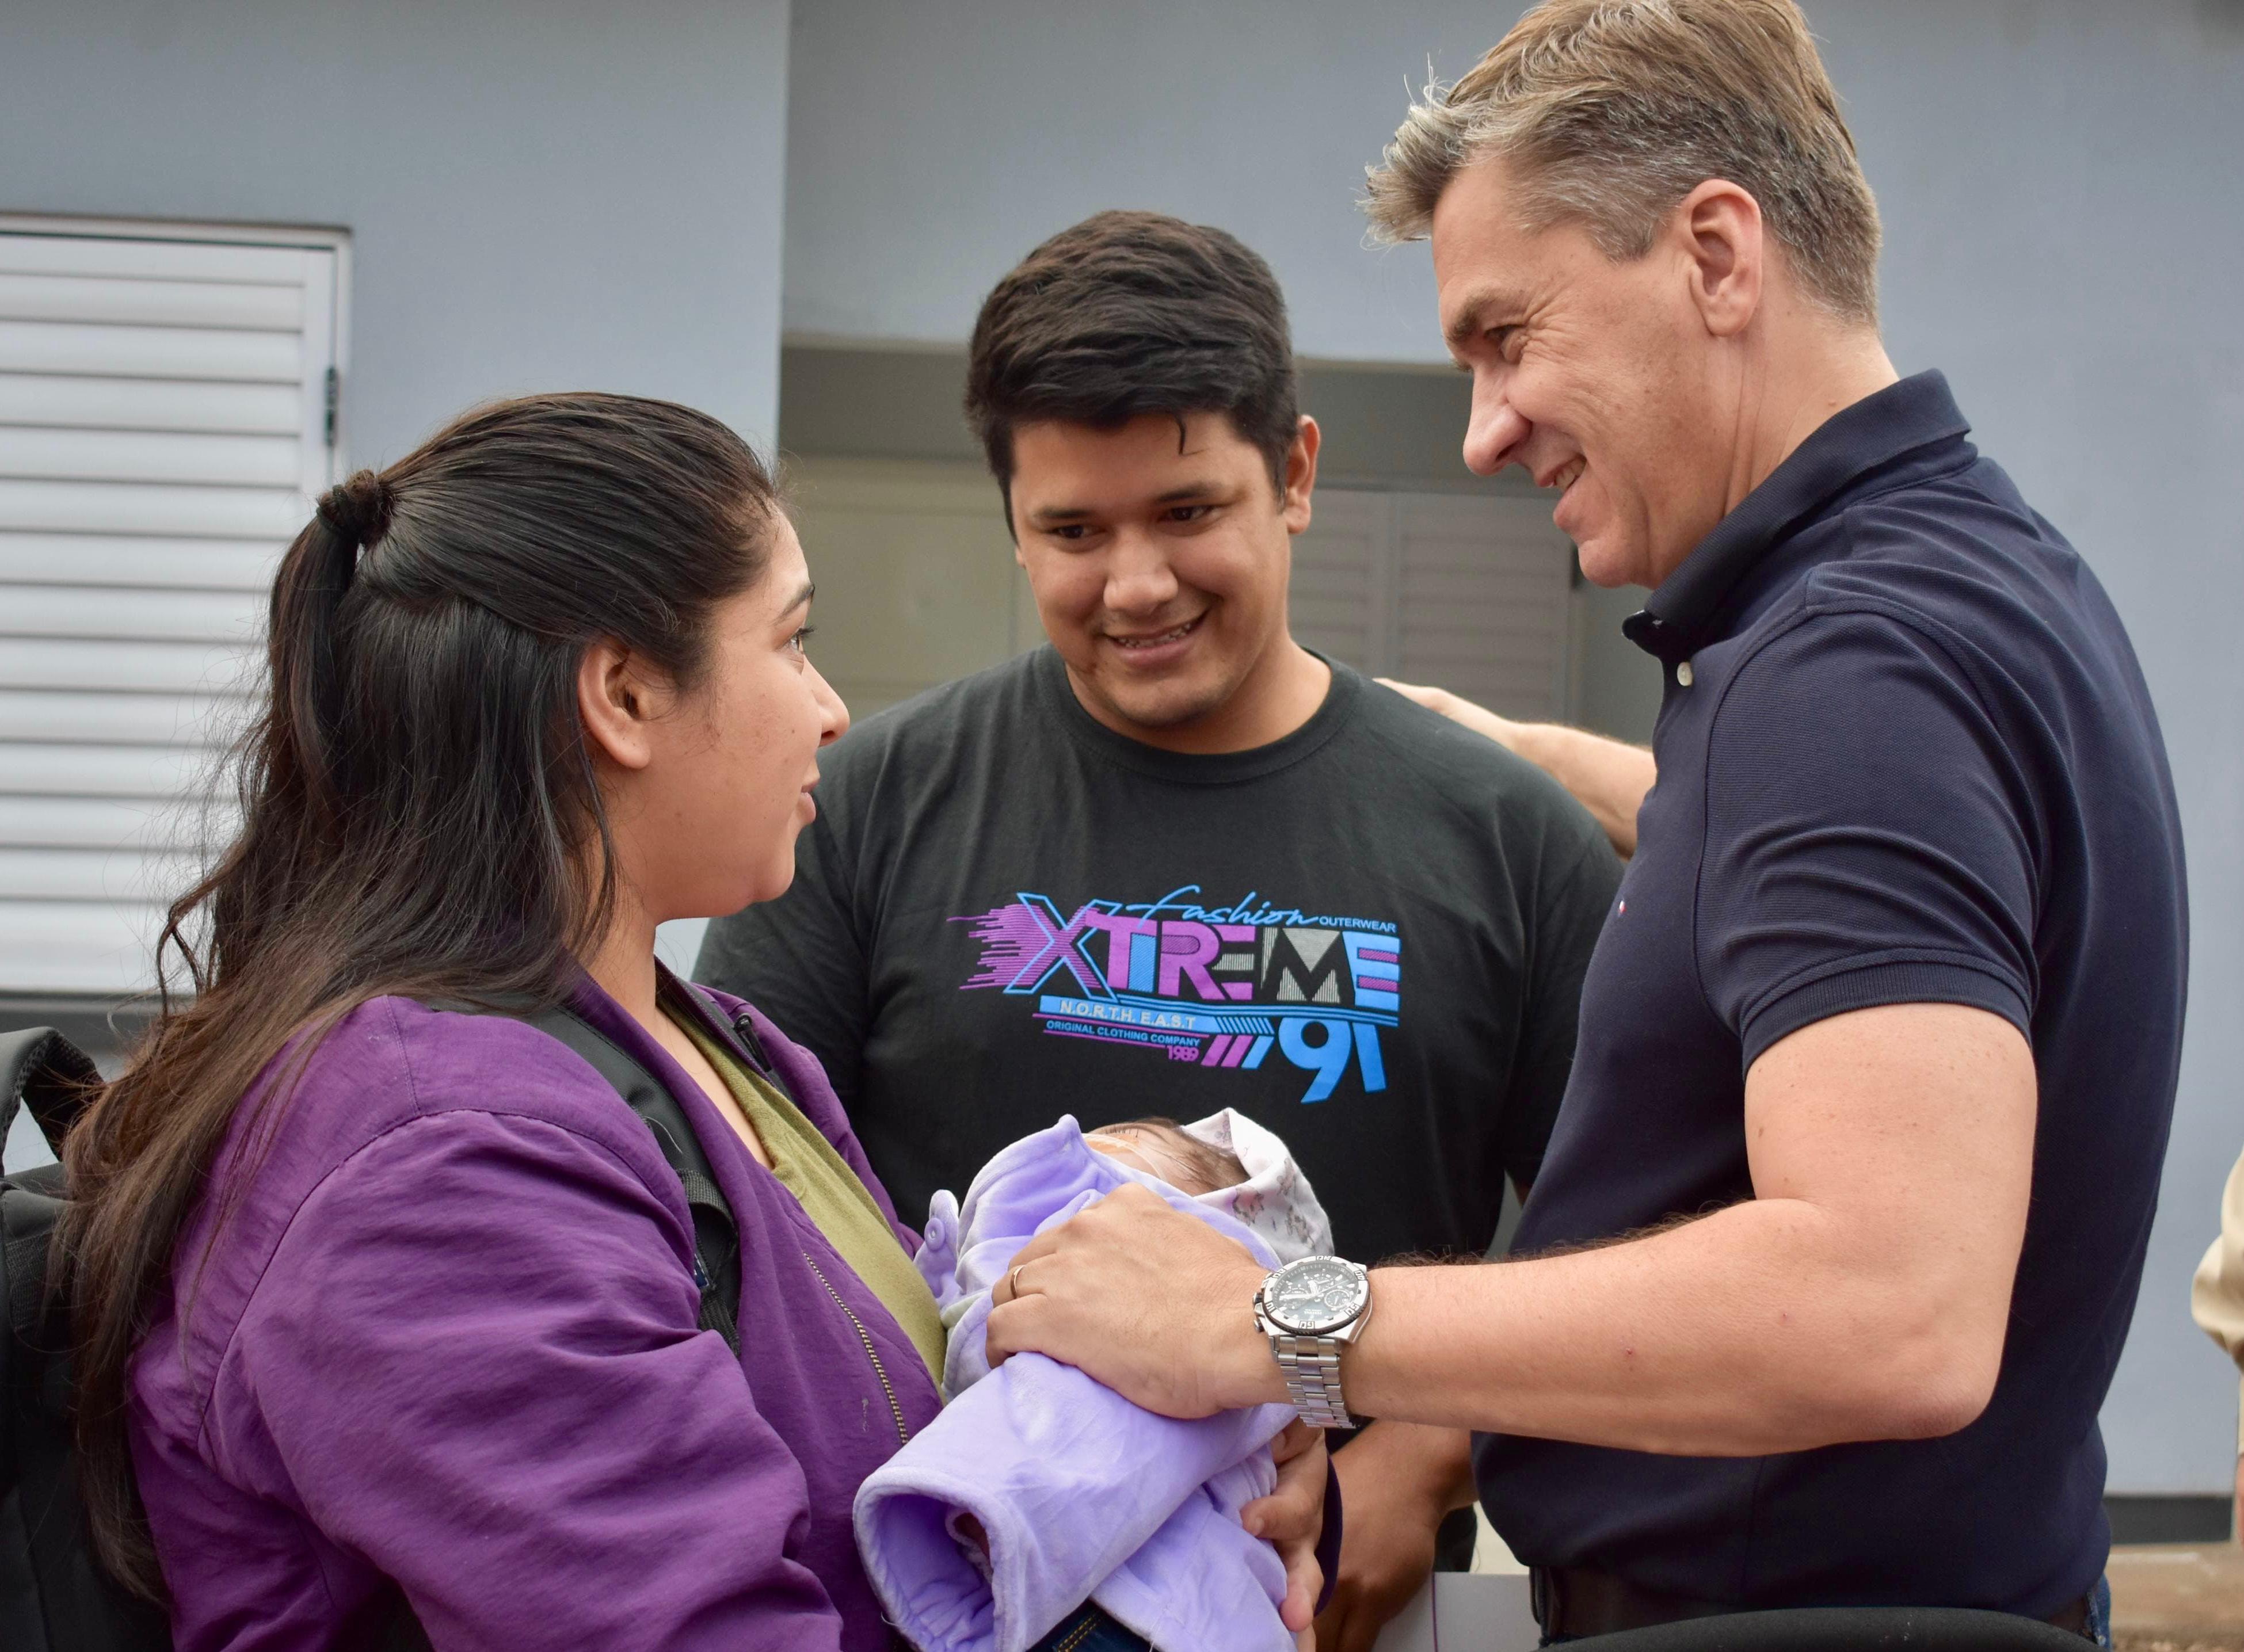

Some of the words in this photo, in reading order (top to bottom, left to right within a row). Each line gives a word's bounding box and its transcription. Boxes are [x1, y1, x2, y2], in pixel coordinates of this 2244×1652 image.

[1319, 915, 1397, 933] OUTERWEAR
[1003, 891, 1401, 1012] XTREME
[1140, 1012, 1196, 1030] E.A.S.T
[1046, 1020, 1095, 1034] ORIGINAL
[1096, 1027, 1148, 1041] CLOTHING
[1150, 1032, 1201, 1047] COMPANY
[1166, 1045, 1199, 1062] 1989
